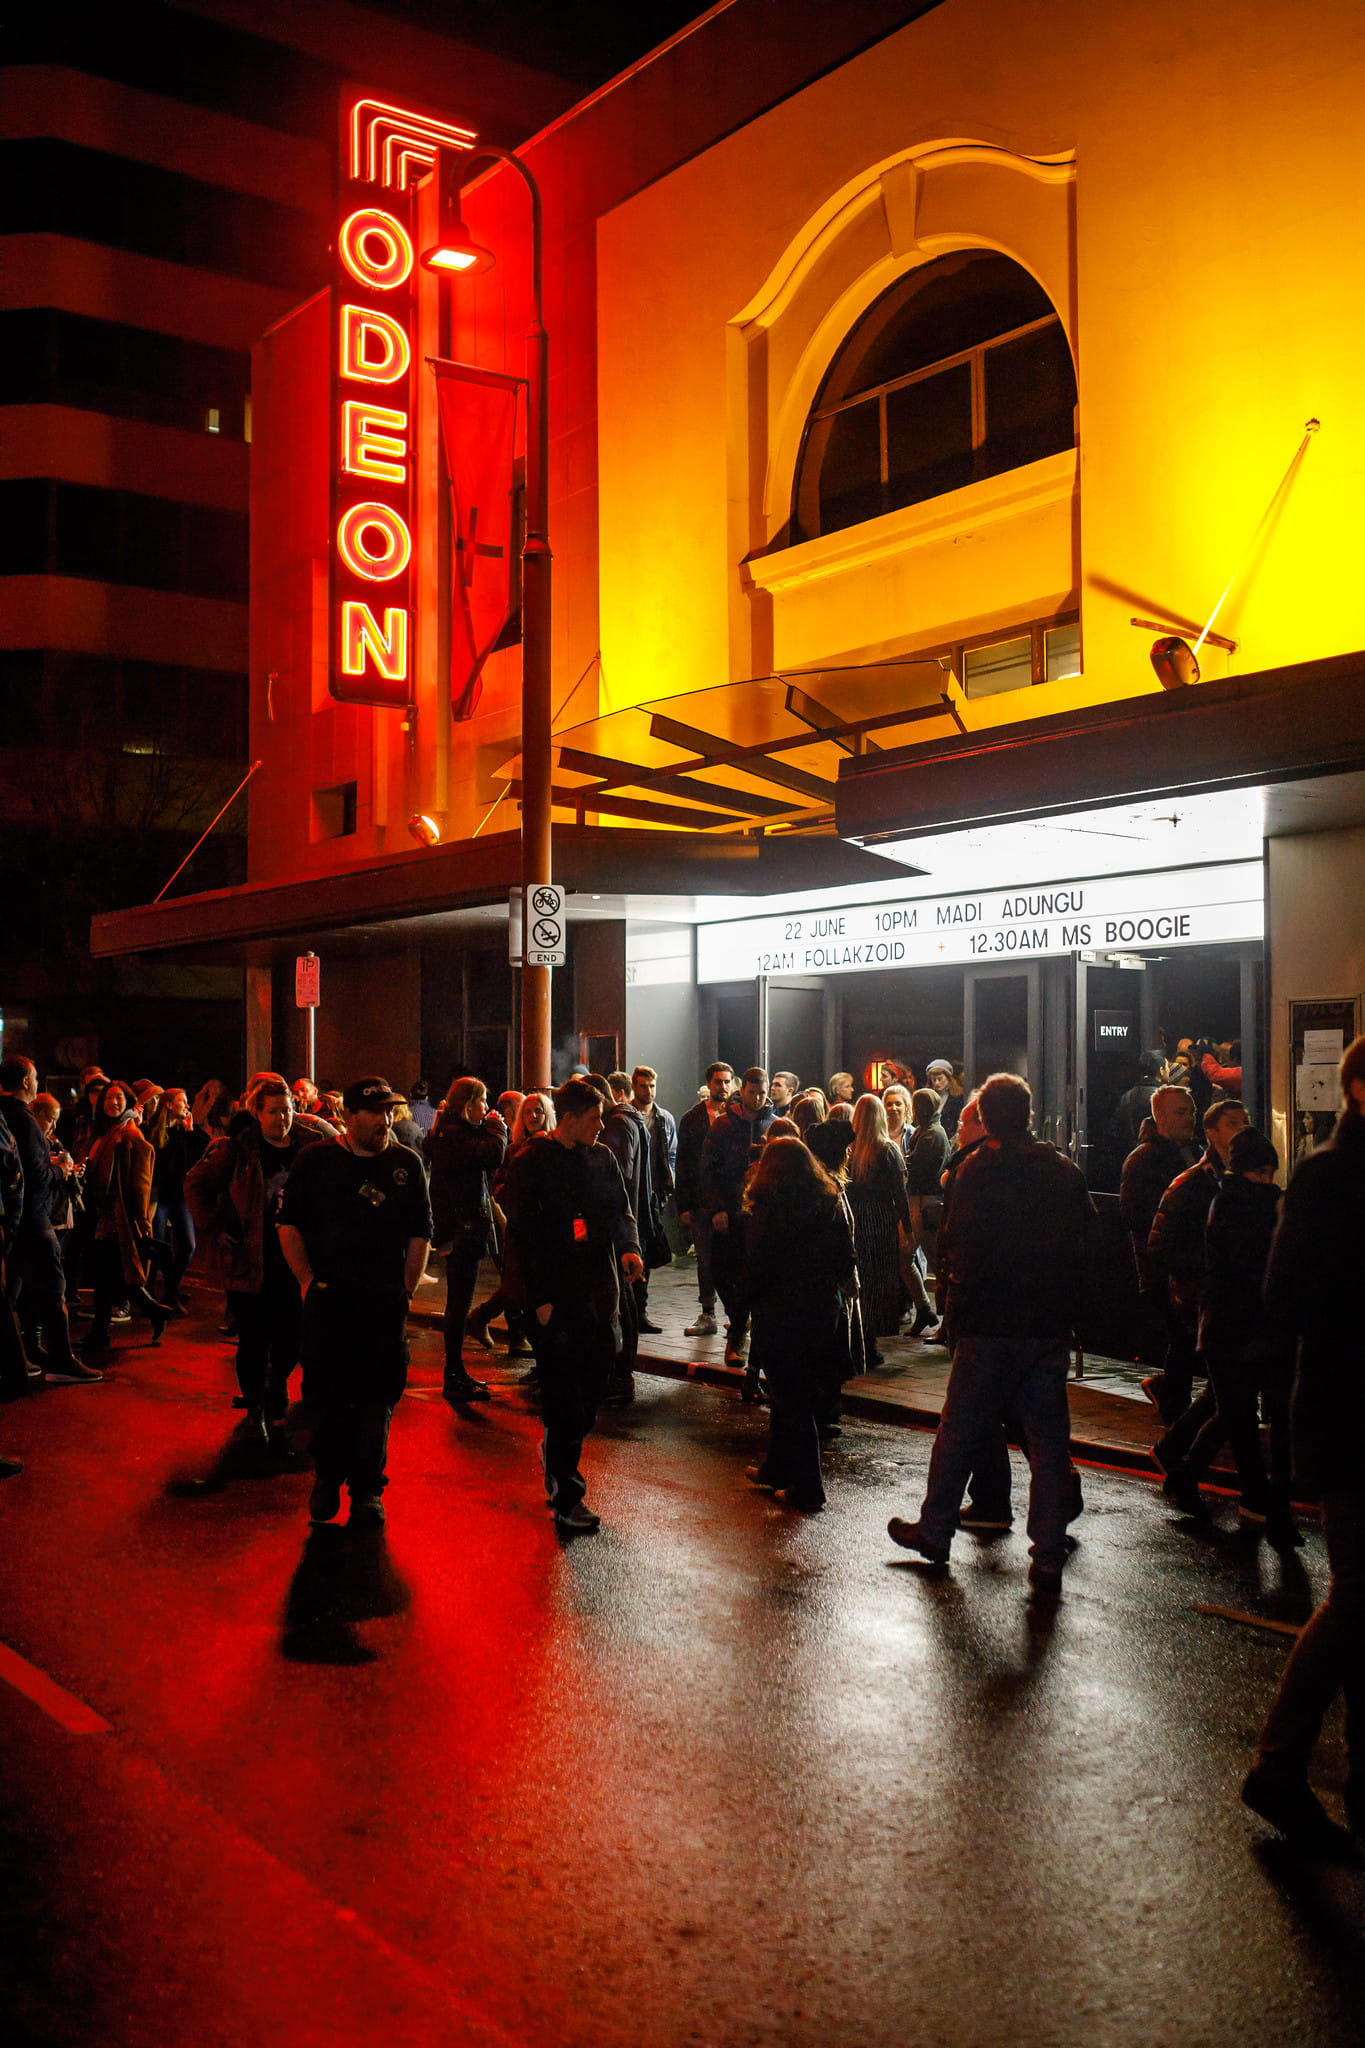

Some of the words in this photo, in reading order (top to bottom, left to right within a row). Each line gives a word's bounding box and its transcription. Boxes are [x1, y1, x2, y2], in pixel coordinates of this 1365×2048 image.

[338, 207, 413, 680] ODEON
[784, 922, 802, 940] 22
[810, 917, 846, 938] JUNE
[874, 908, 917, 931] 10PM
[936, 902, 982, 926] MADI
[1001, 890, 1084, 918] ADUNGU
[536, 954, 557, 962] END
[757, 952, 794, 972] 12AM
[805, 942, 905, 968] FOLLAKZOID
[969, 928, 1049, 954] 12.30AM
[1062, 924, 1091, 946] MS
[1105, 914, 1191, 943] BOOGIE
[1100, 1025, 1128, 1037] ENTRY
